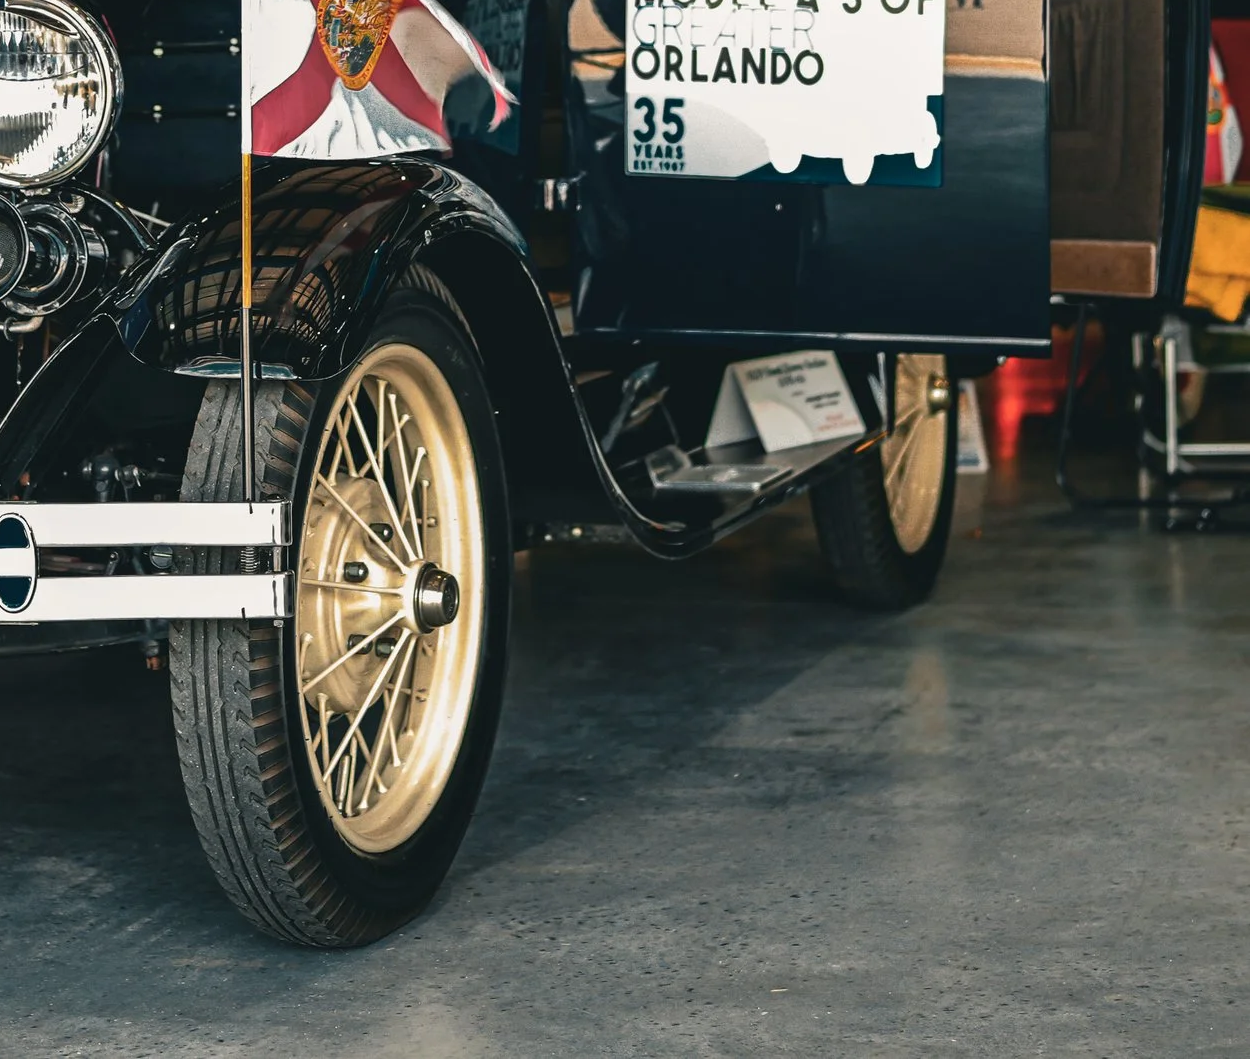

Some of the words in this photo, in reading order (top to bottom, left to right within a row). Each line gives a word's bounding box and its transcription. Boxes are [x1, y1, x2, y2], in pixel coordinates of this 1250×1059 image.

[632, 4, 816, 53] GREATER
[632, 45, 825, 86] ORLANDO
[633, 97, 685, 144] 35
[633, 144, 684, 160] YEARS
